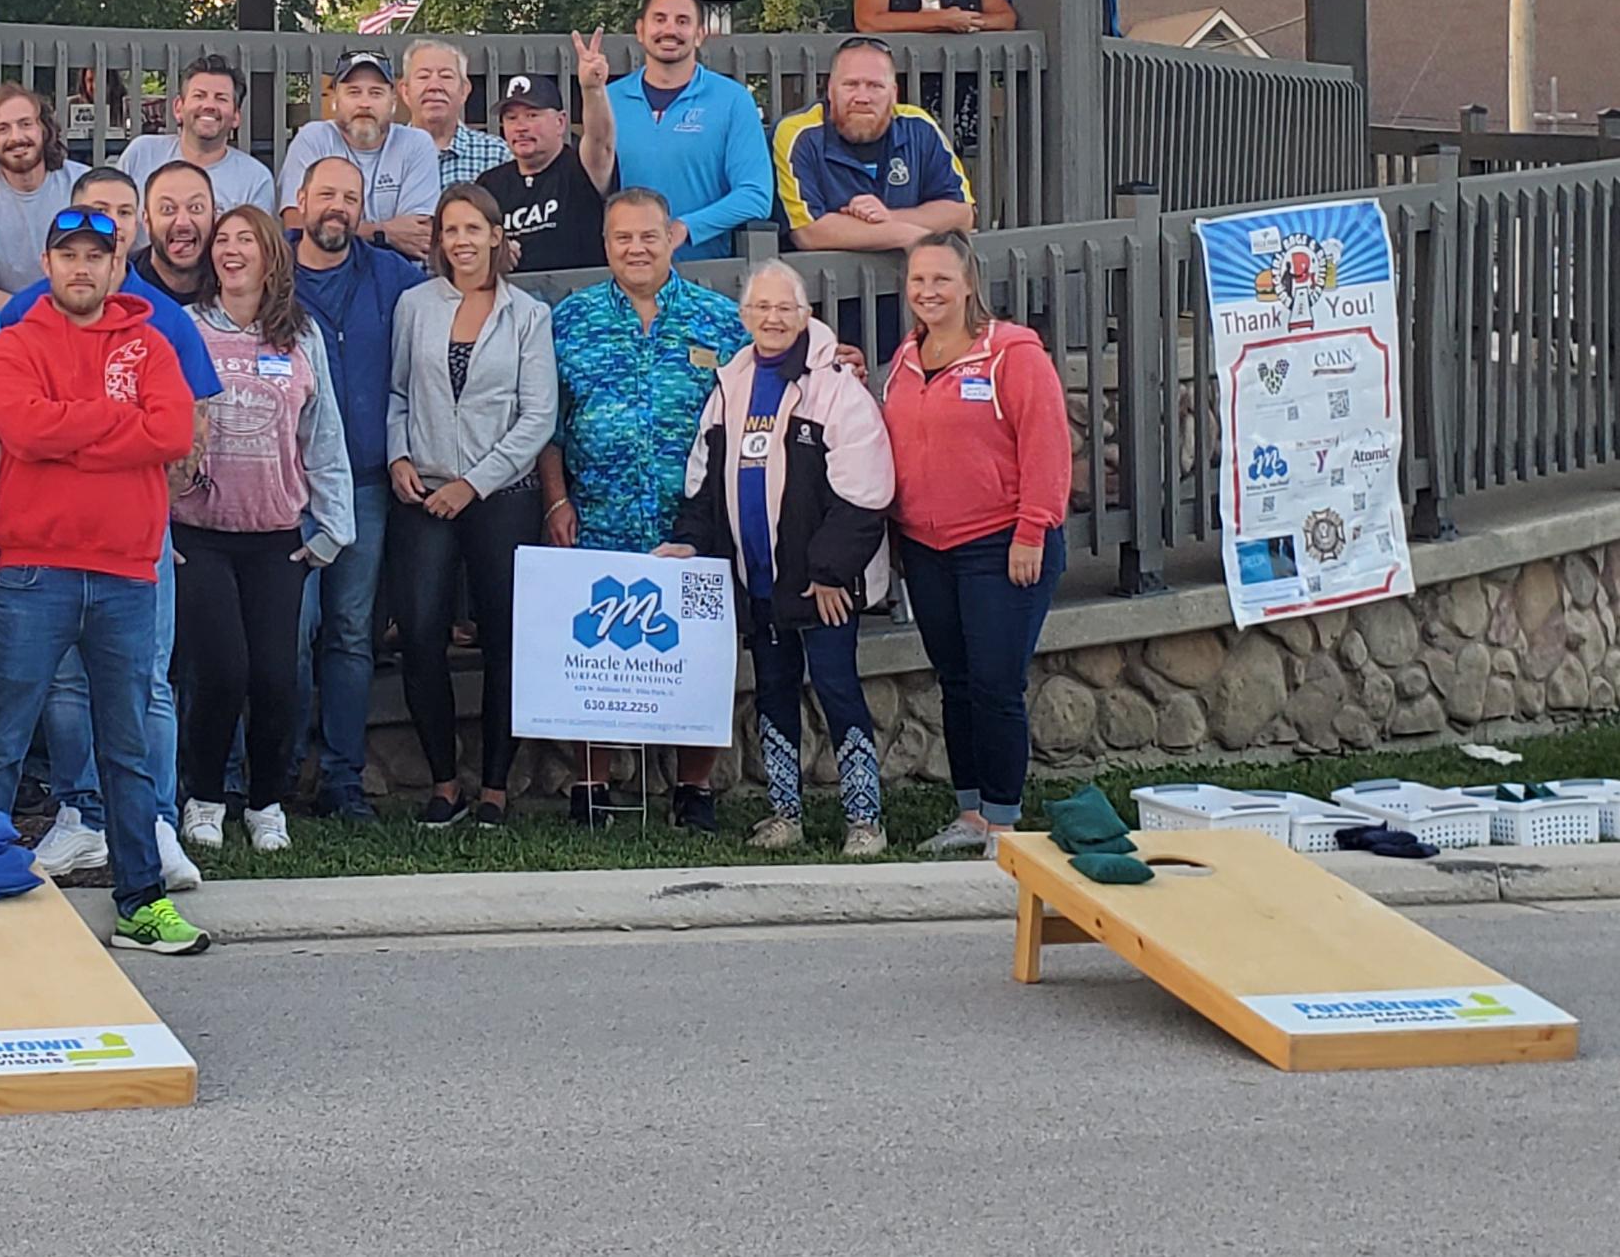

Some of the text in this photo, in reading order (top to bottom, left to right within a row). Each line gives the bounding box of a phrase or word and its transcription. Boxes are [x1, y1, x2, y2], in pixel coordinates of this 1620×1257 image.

[1220, 292, 1376, 334] Thank You!
[1314, 348, 1353, 368] CAIN
[1352, 447, 1391, 462] Atomic
[565, 654, 683, 674] Miracle Method
[565, 671, 683, 685] SURFACE REFINISHING
[584, 699, 659, 714] 630.832.2250
[1292, 999, 1464, 1014] PorteBrown
